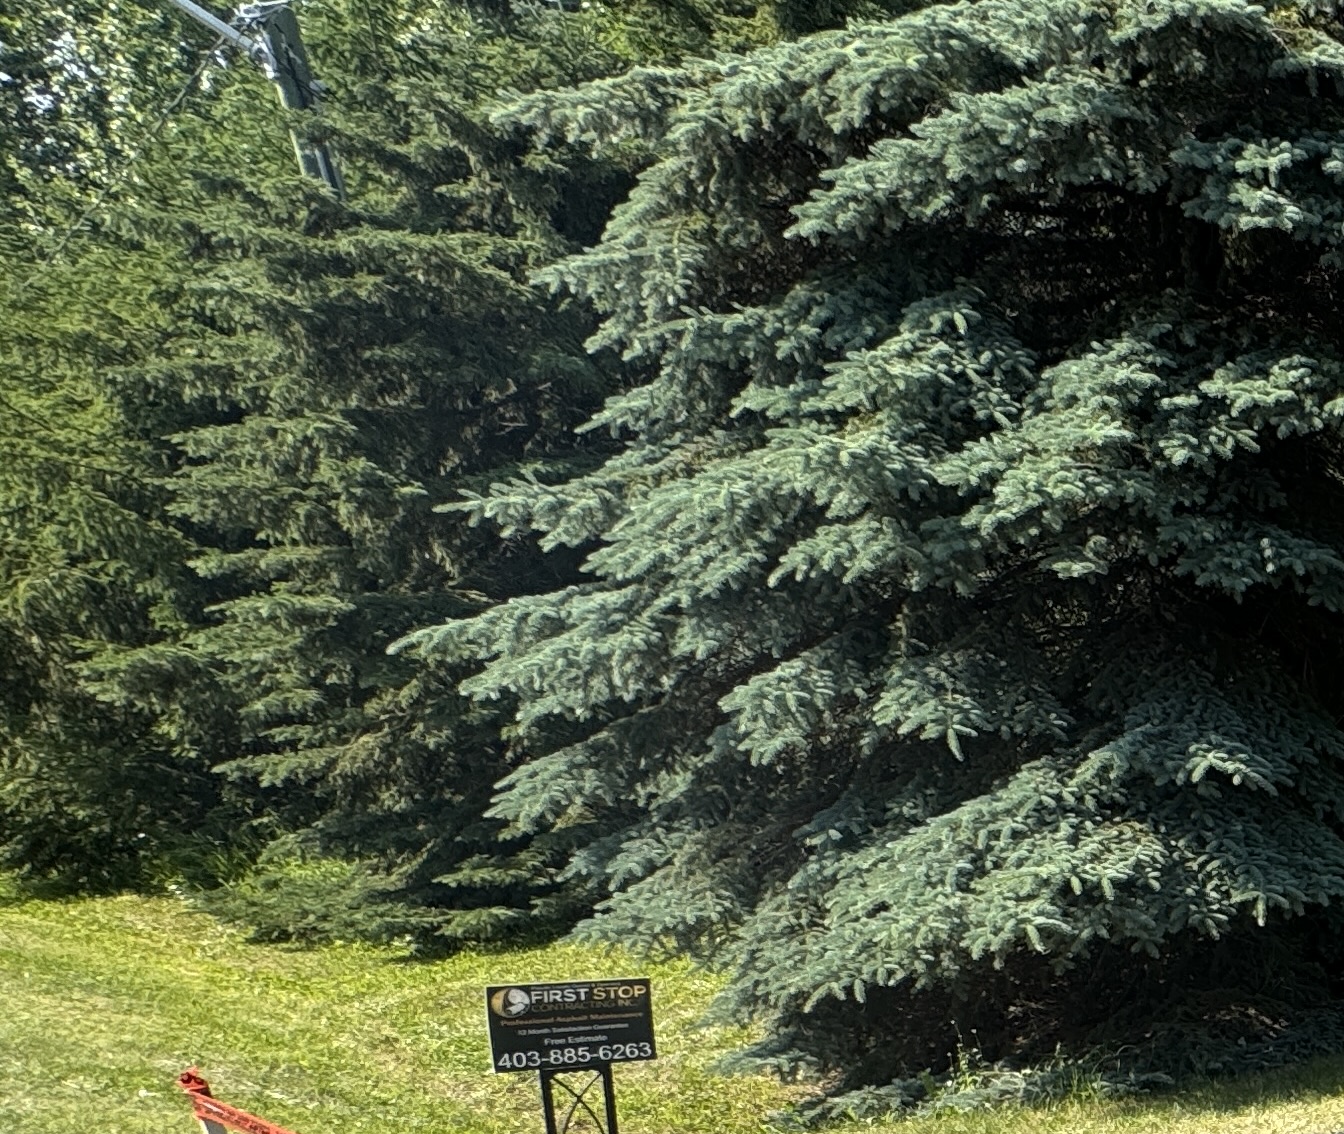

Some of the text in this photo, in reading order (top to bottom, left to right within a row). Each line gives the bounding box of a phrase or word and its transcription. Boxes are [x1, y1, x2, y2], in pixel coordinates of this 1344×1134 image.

[530, 988, 589, 1005] FIRST
[592, 984, 647, 1001] STOP
[543, 1034, 609, 1046] Free Estimate
[497, 1042, 652, 1069] 403-885-6263
